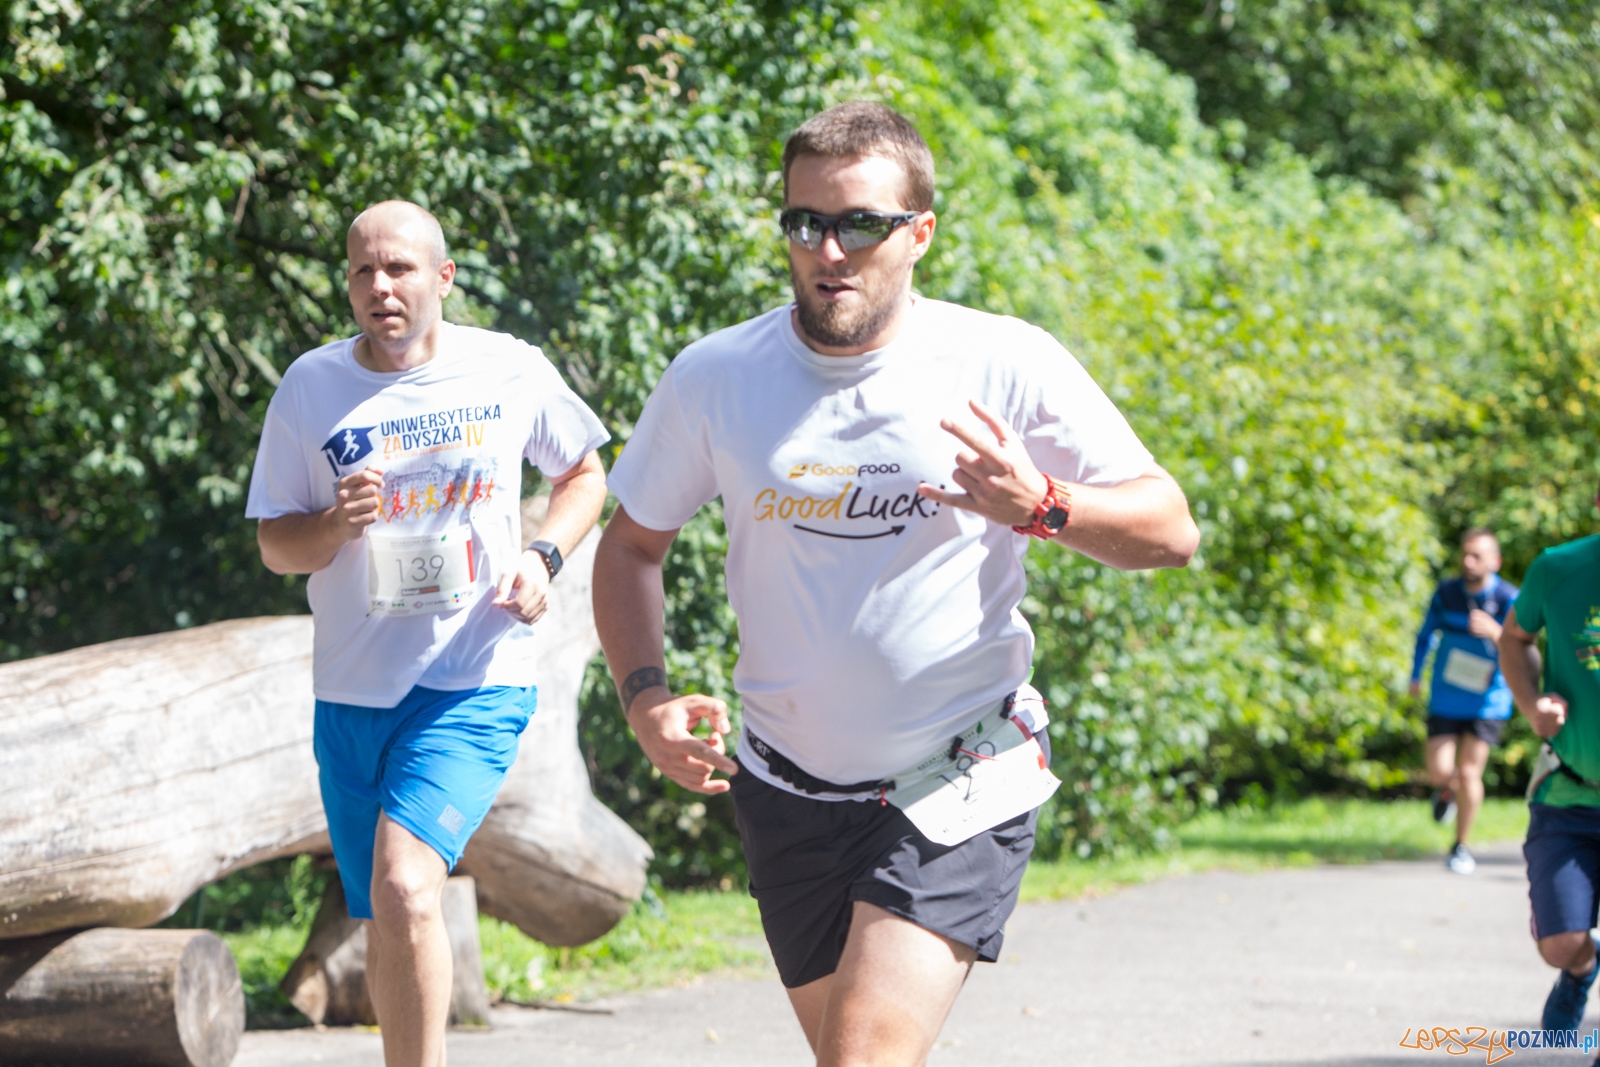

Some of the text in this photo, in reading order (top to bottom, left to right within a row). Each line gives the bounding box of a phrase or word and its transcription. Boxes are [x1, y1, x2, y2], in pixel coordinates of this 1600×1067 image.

[380, 404, 502, 437] UNIWERSYTECKA
[382, 425, 463, 454] ZADYSZKA
[466, 423, 485, 447] IV
[396, 554, 445, 583] 139
